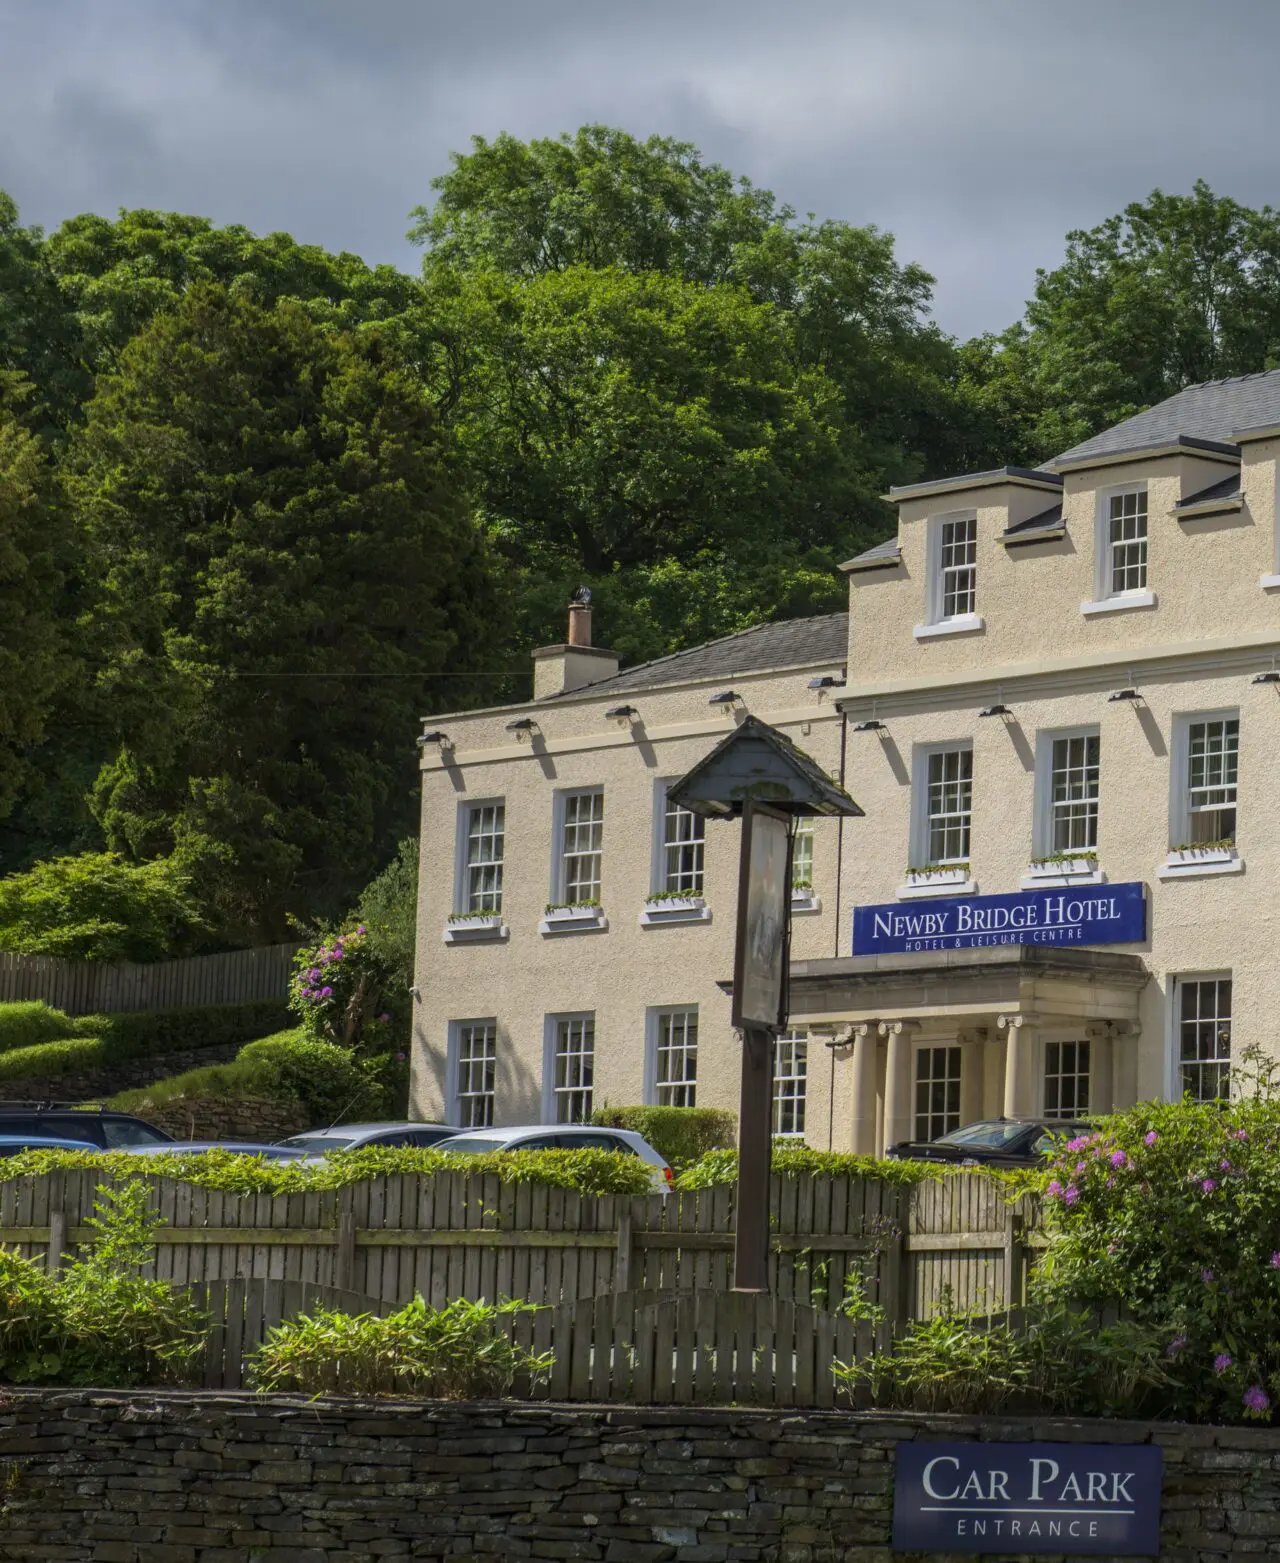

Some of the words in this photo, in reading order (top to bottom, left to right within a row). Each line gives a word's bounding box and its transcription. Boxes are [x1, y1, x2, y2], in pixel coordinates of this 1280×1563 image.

[872, 911, 949, 938] NEWBY
[957, 905, 1037, 932] BRIDGE
[1044, 896, 1121, 923] HOTEL
[905, 940, 945, 952] HOTEL
[955, 938, 962, 948] &
[971, 933, 1024, 947] LEISURE
[1033, 928, 1083, 942] CENTRE
[922, 1456, 1011, 1501] CAR
[1027, 1458, 1136, 1502] PARK
[957, 1519, 1098, 1537] ENTRANCE
